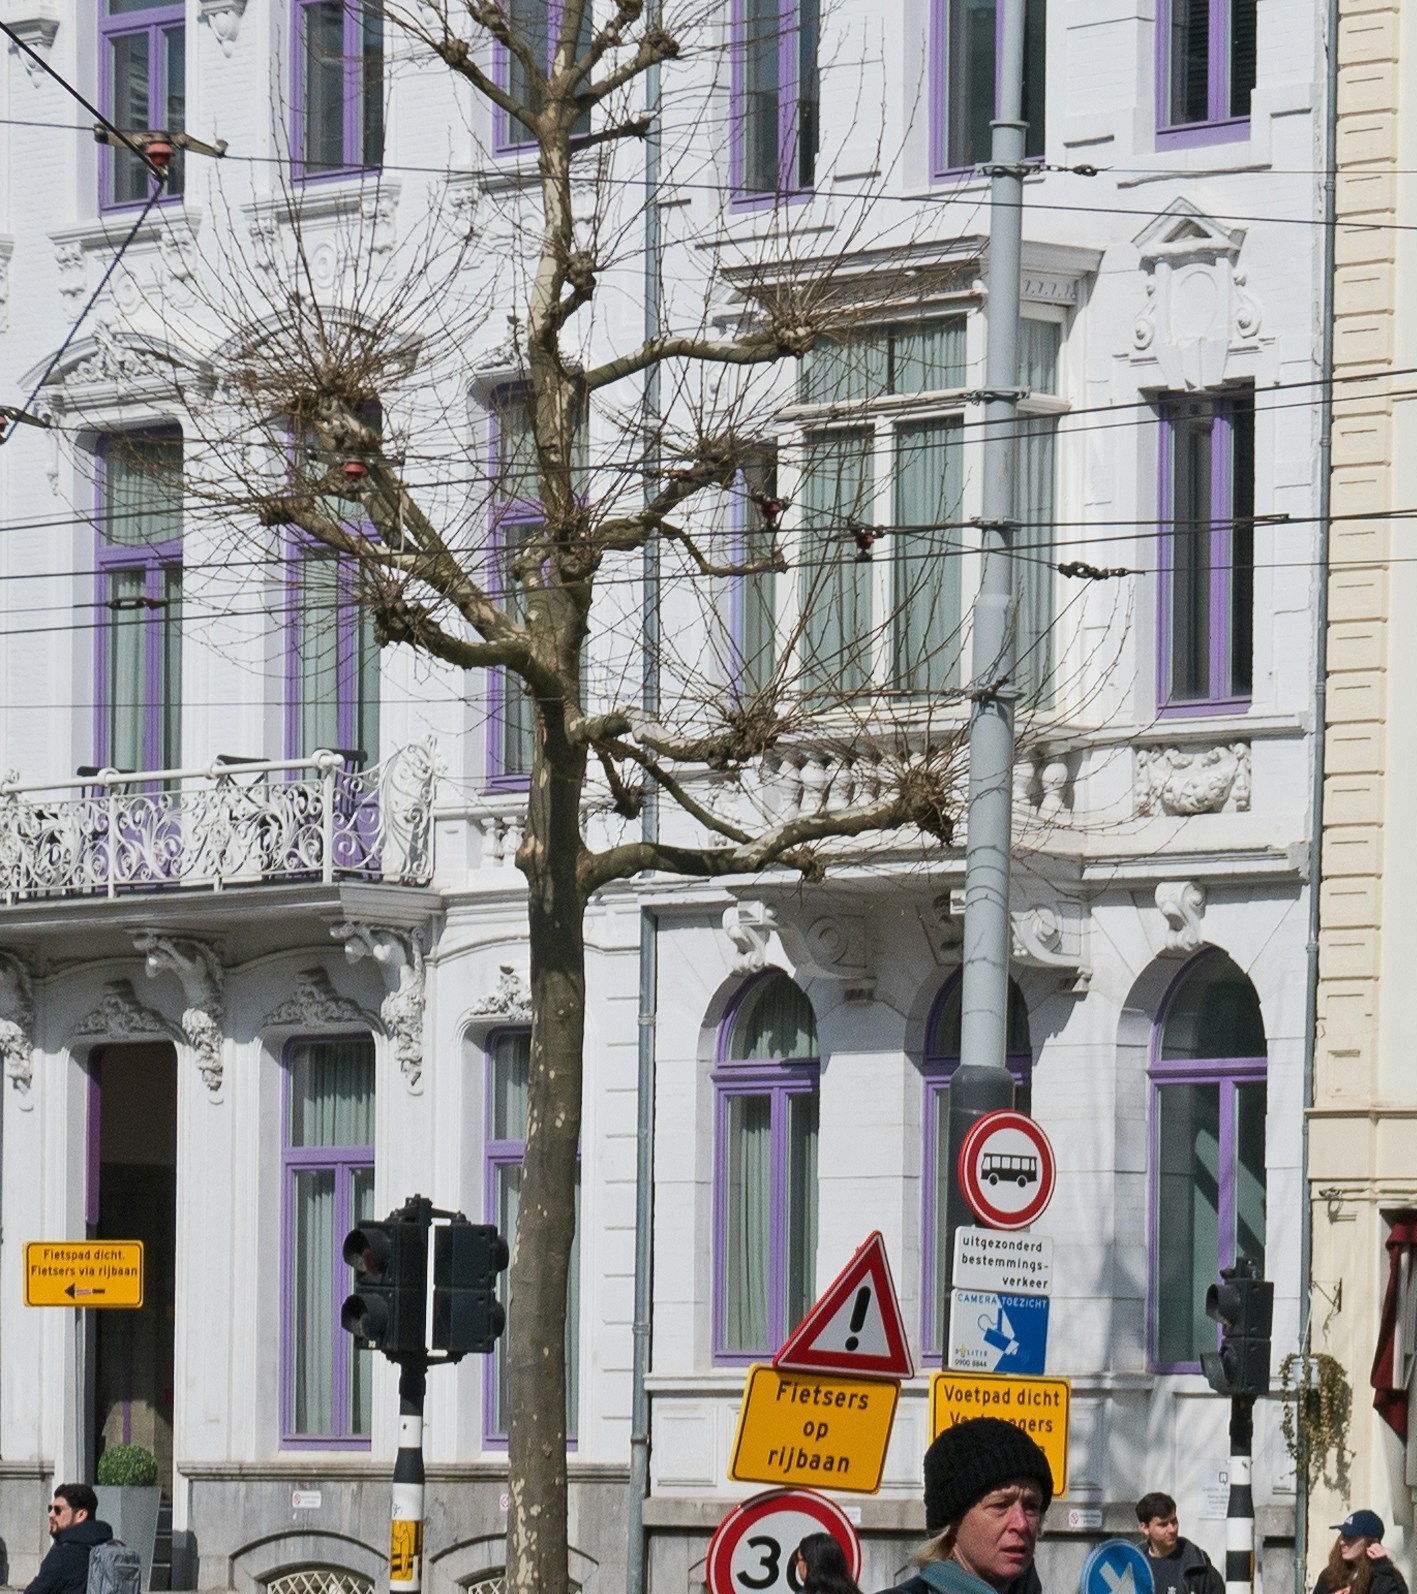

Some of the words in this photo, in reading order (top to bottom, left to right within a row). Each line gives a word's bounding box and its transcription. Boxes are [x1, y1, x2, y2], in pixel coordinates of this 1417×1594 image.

[962, 1235, 1043, 1252] uitgezonderd
[43, 1249, 91, 1262] Fietspad
[961, 1252, 1049, 1273] bestemmings-
[31, 1265, 76, 1277] Fietsers
[78, 1266, 95, 1277] via
[98, 1265, 139, 1280] rijbaan
[1002, 1276, 1049, 1289] verkeer
[957, 1293, 998, 1304] CAMERA
[1001, 1296, 1048, 1309] TOEZICHT
[776, 1380, 869, 1410] Fietsers
[943, 1384, 1011, 1407] Voetpad
[1016, 1388, 1060, 1407] dicht
[803, 1420, 829, 1442] op
[767, 1446, 850, 1474] rijbaan
